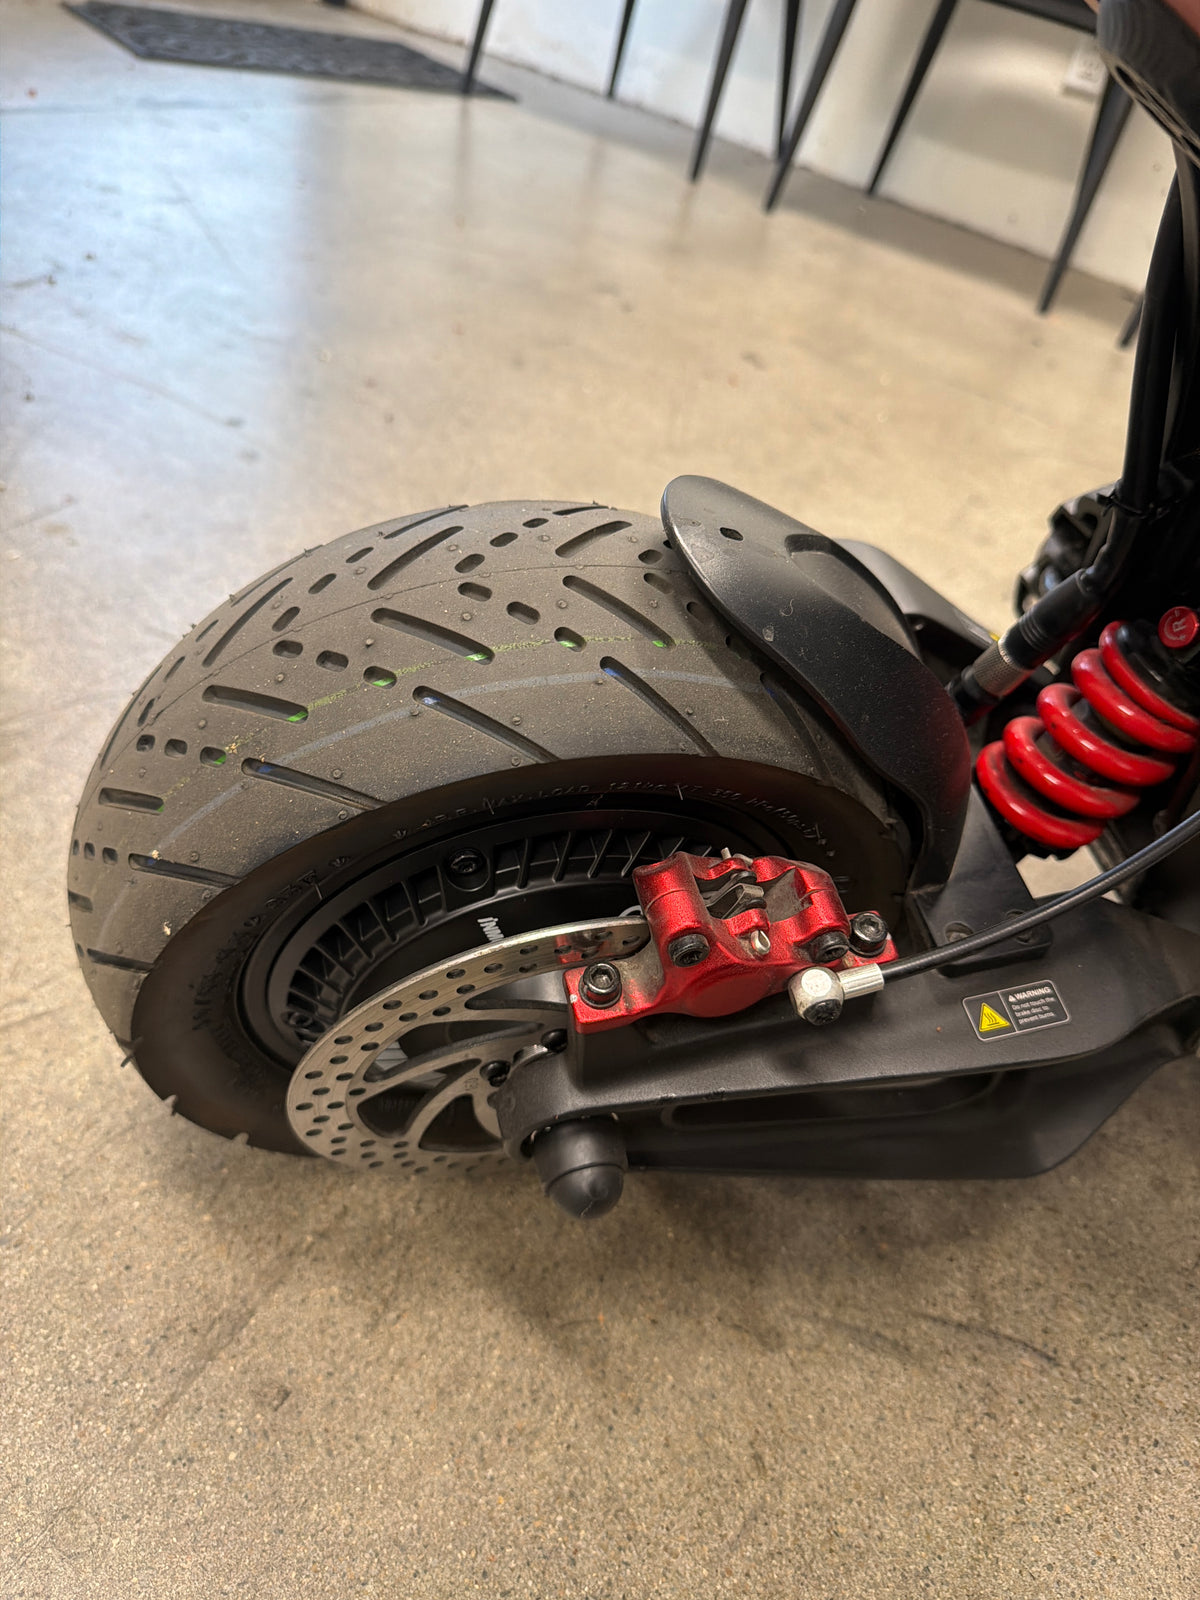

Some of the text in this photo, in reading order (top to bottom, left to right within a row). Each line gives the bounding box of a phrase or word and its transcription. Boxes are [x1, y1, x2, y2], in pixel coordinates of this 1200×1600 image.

[1014, 987, 1052, 1000] WARNING
[1030, 998, 1045, 1006] touch
[1018, 1015, 1038, 1024] prevent
